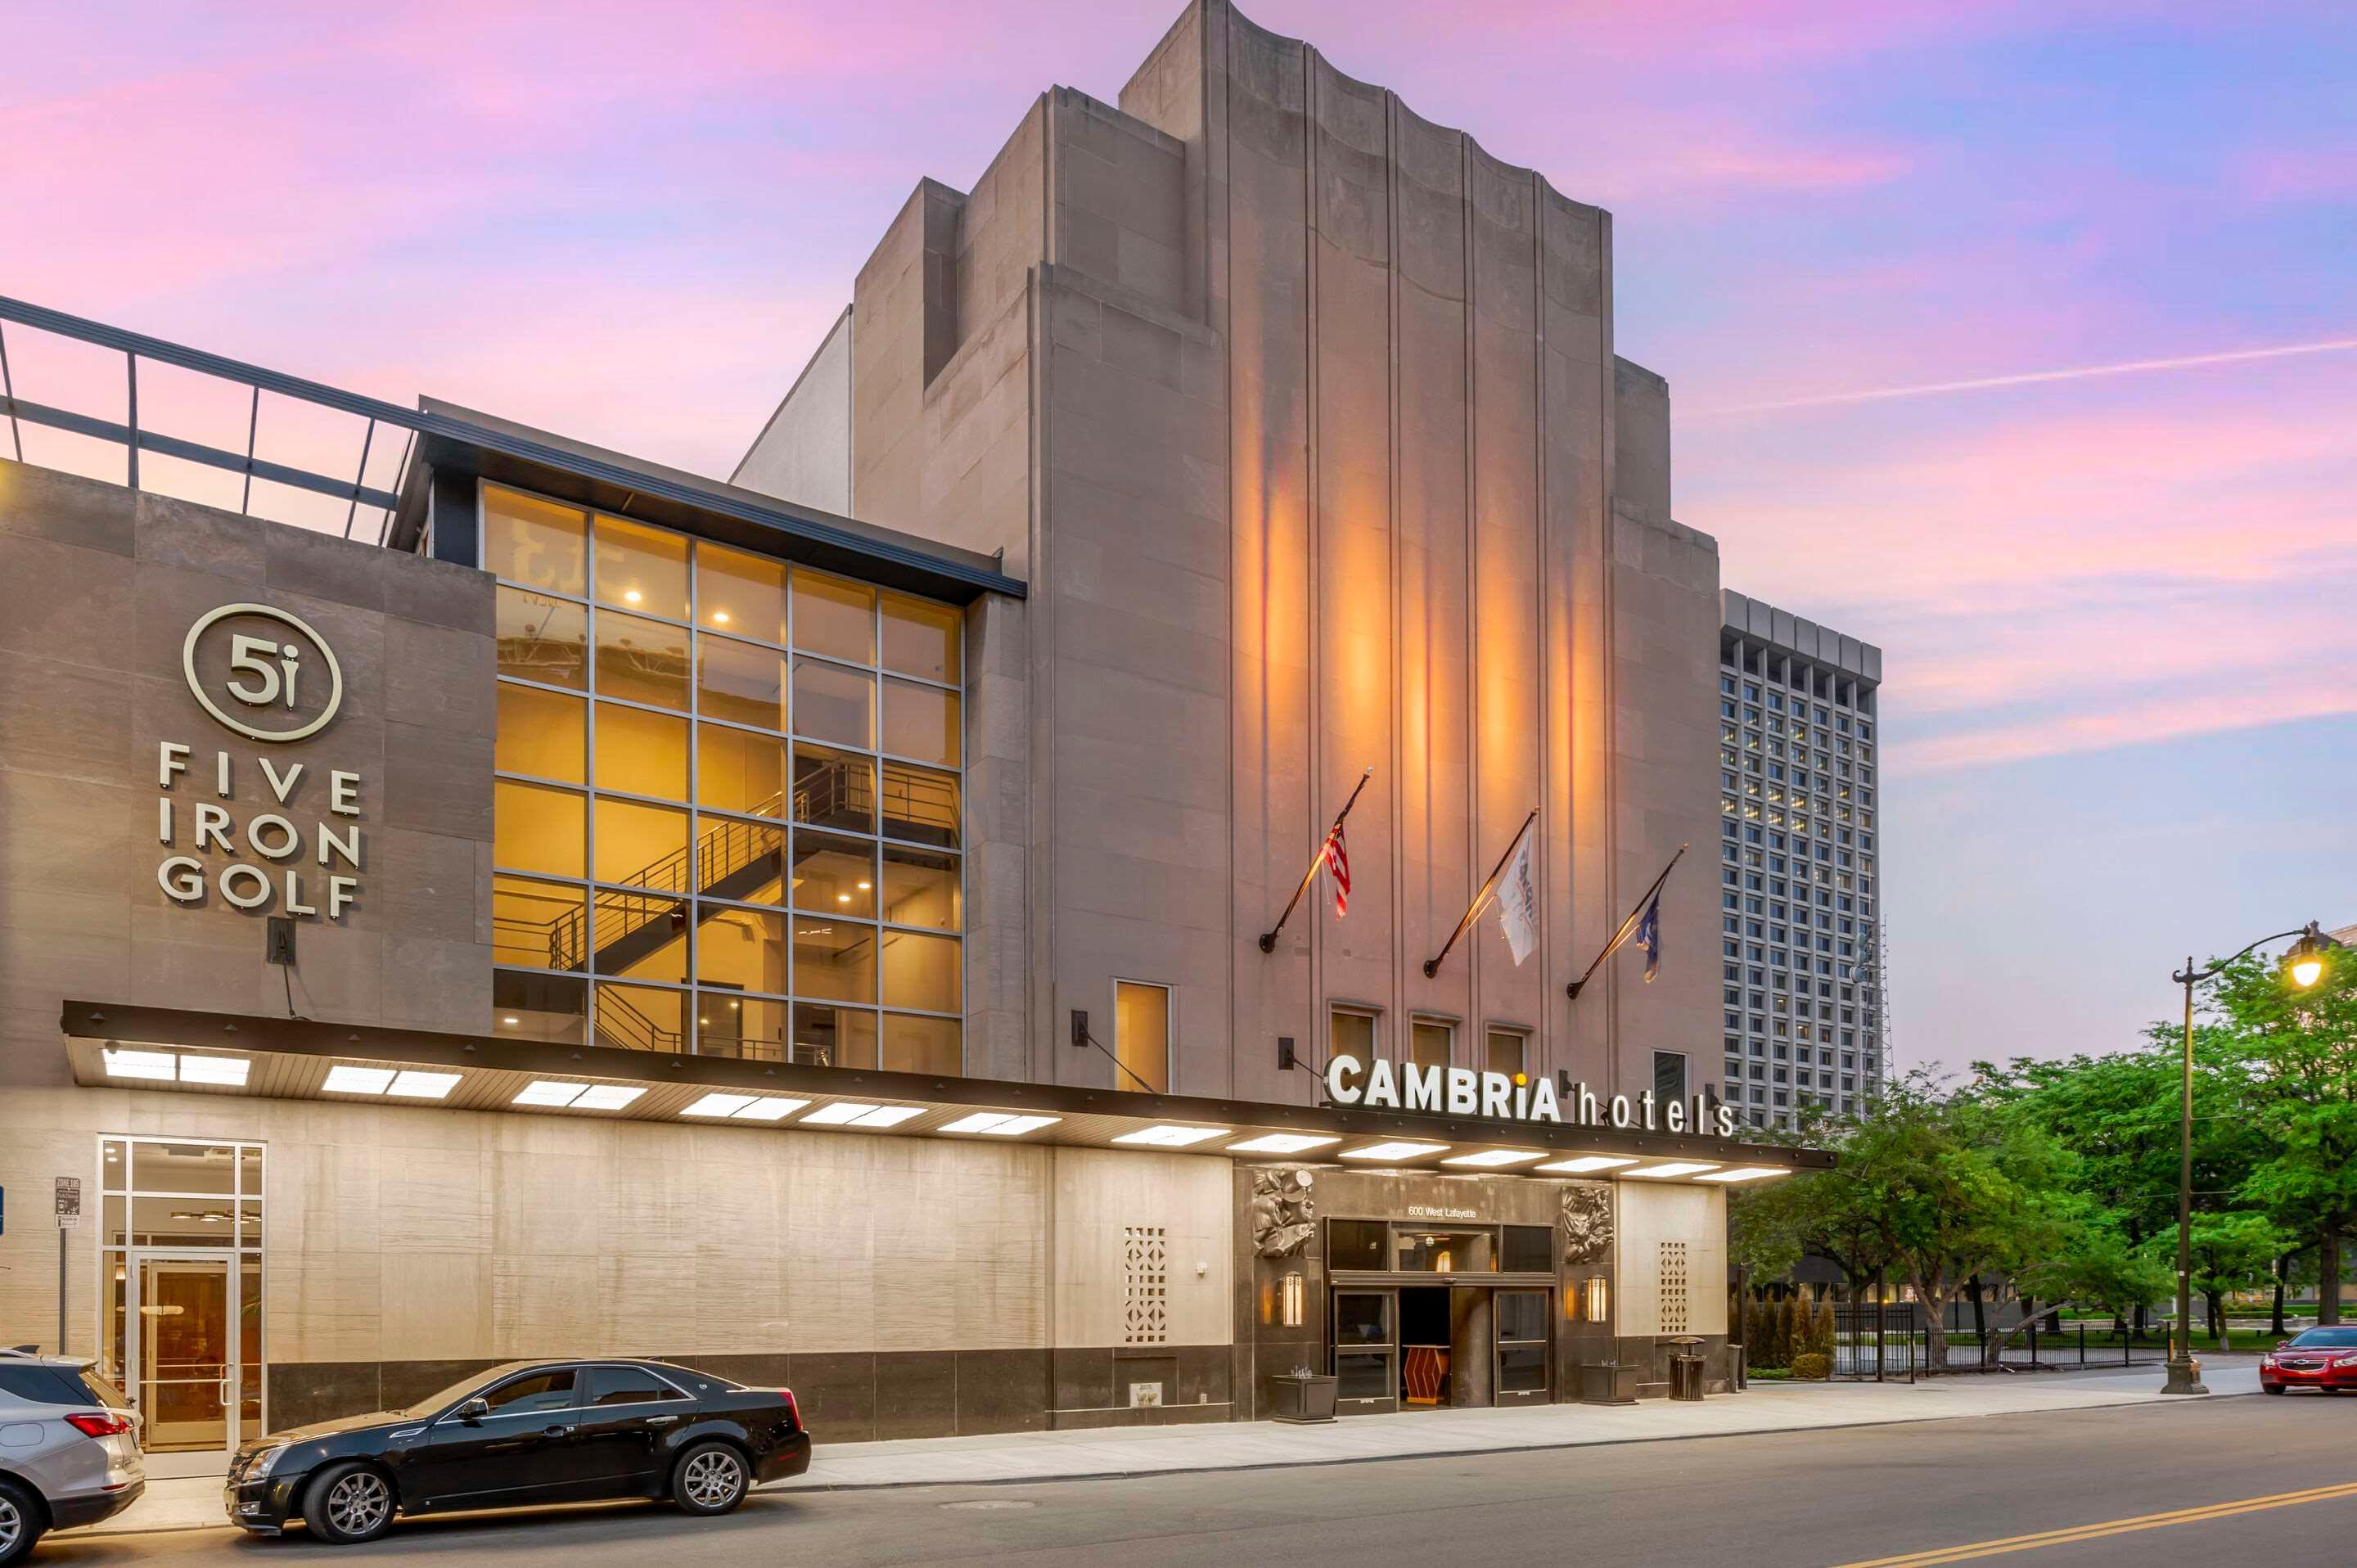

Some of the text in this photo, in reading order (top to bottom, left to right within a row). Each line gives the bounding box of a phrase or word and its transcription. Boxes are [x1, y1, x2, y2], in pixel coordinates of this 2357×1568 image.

[226, 633, 300, 710] 5i
[159, 741, 360, 815] FIVE
[159, 796, 360, 870] IRON
[157, 855, 358, 918] GOLF
[1575, 1081, 1733, 1138] hotels
[1408, 1205, 1476, 1219] 600 West Lafayette
